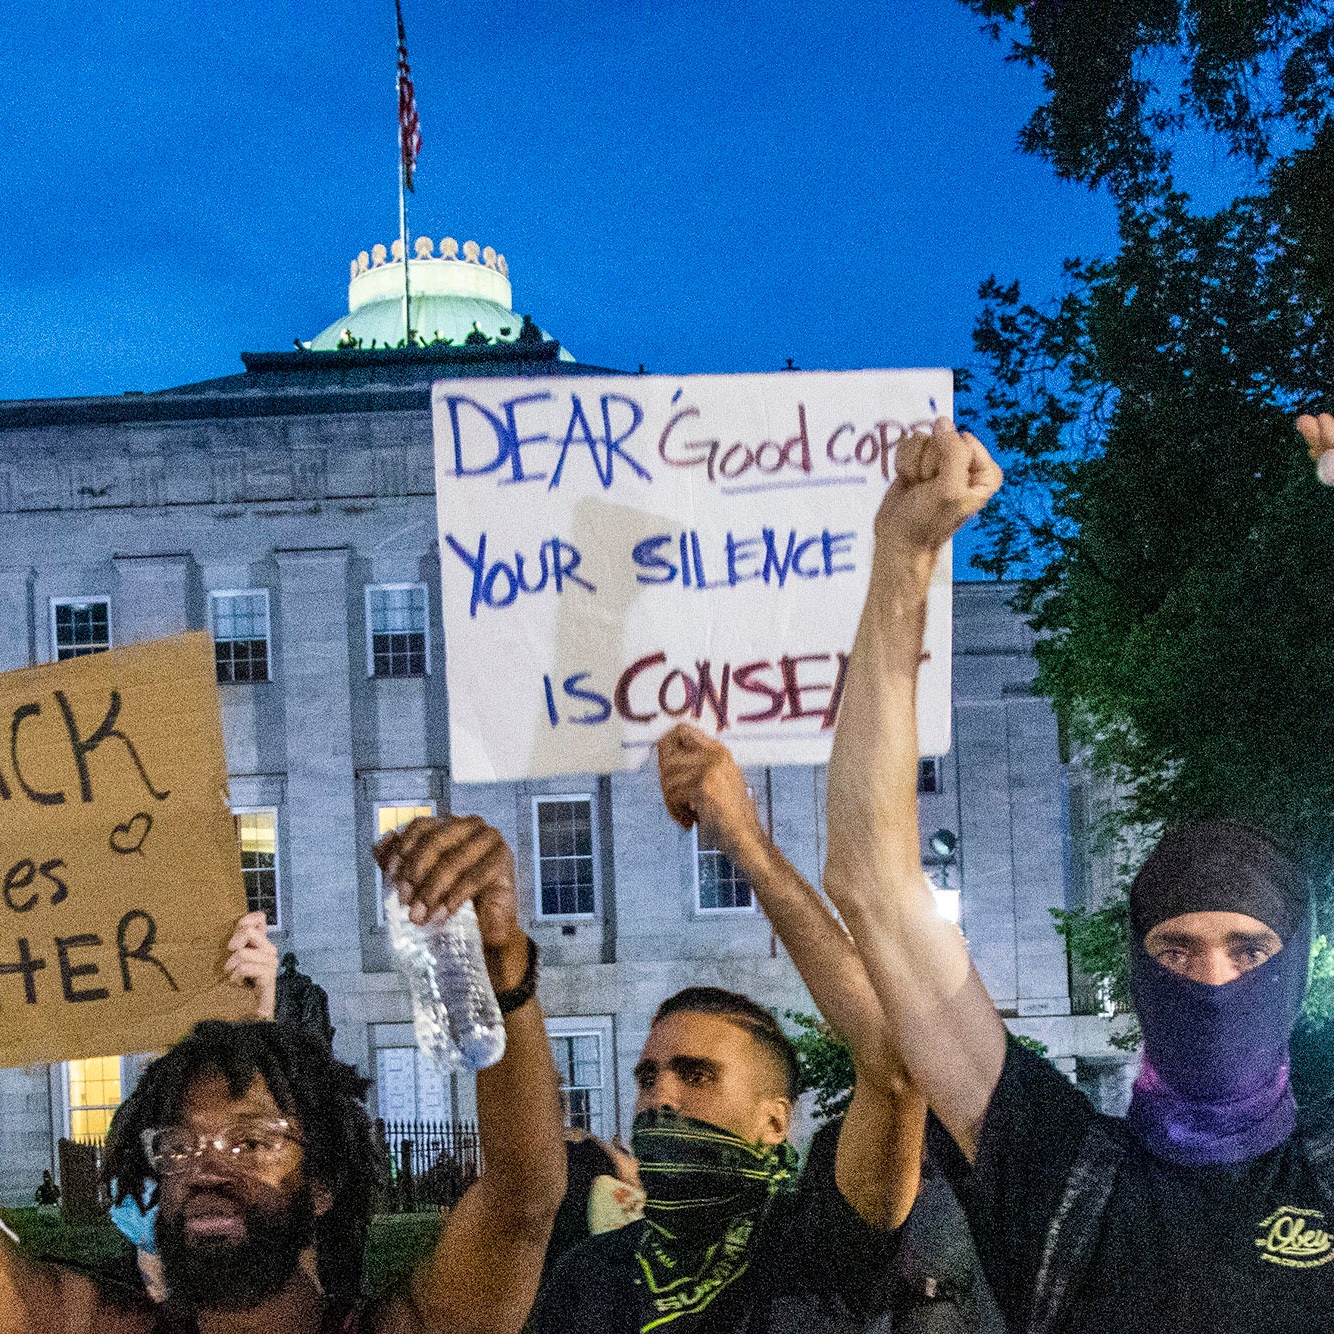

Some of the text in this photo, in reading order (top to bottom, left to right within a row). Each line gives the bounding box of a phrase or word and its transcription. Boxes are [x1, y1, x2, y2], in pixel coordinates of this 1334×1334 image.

[443, 392, 652, 491] DEAR
[446, 526, 857, 618] YOUR SILENCE
[544, 652, 932, 734] IS CONSE
